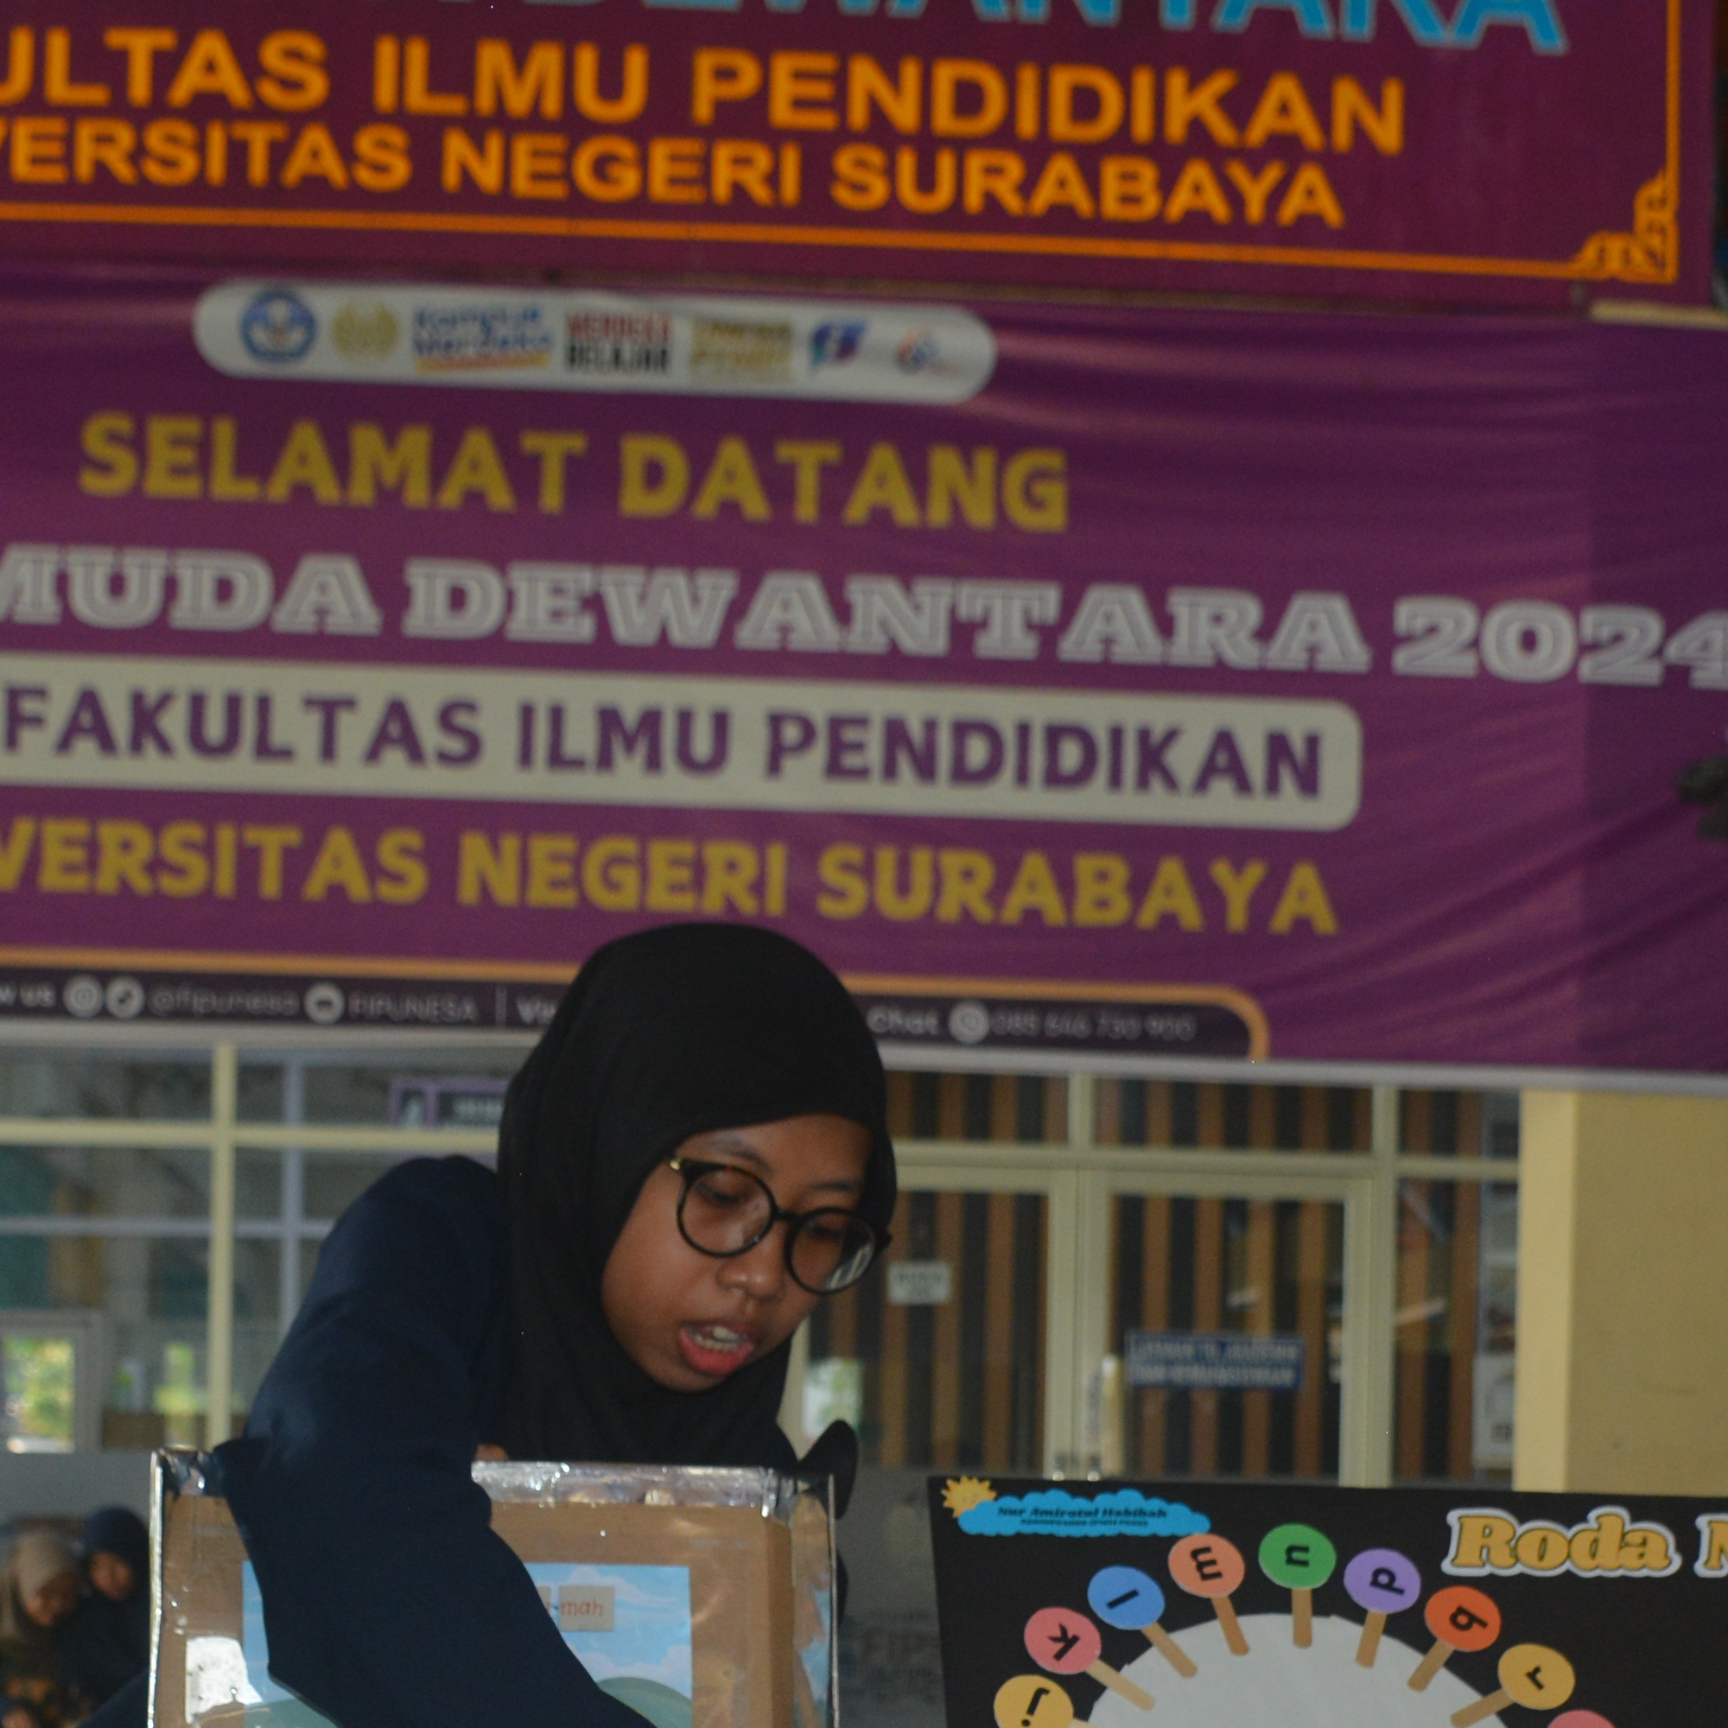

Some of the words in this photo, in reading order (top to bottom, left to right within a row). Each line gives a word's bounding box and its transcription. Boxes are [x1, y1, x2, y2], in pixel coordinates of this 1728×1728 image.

[375, 37, 647, 122] ILMU
[692, 49, 1404, 154] PENDIDIKAN
[442, 132, 799, 206] NEGERI
[832, 147, 1343, 229] SURABAYA
[79, 411, 586, 513] SELAMAT
[617, 434, 1066, 533] DATANG
[402, 559, 1371, 674] DEWANTARA
[4, 684, 482, 769] FAKULTAS
[516, 701, 730, 779] ILMU
[766, 712, 1321, 800] PENDIDIKAN
[458, 833, 785, 917] NEGERI
[816, 843, 1337, 937] SURABAYA
[21, 983, 53, 1006] us
[1449, 1511, 1672, 1574] Roda
